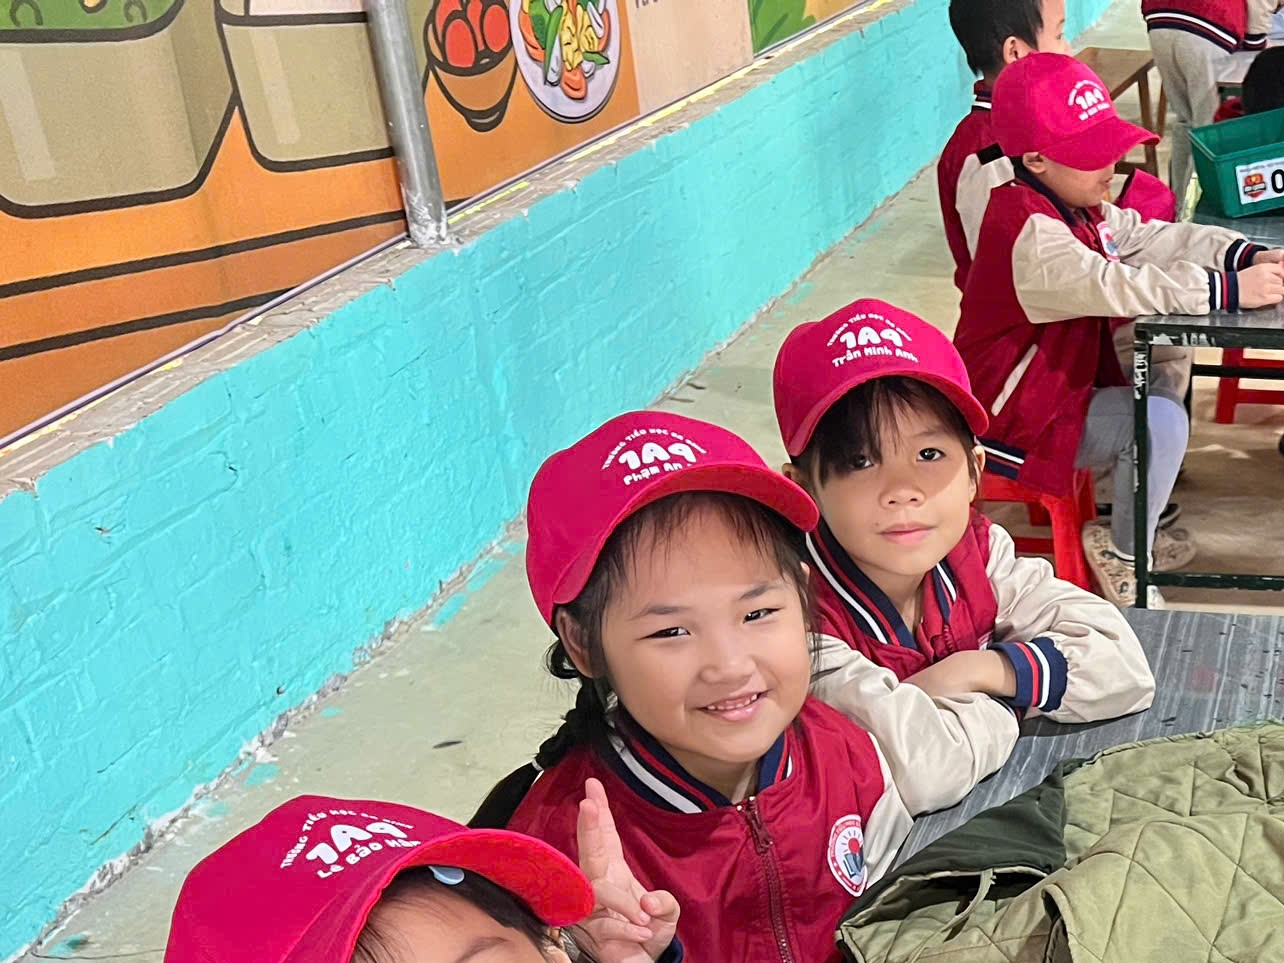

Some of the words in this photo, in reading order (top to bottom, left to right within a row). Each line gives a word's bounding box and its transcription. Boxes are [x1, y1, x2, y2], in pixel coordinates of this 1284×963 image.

[840, 326, 903, 349] 1A9
[618, 442, 696, 470] 1A9
[306, 822, 407, 865] 1A9
[346, 842, 383, 865] Bảo
